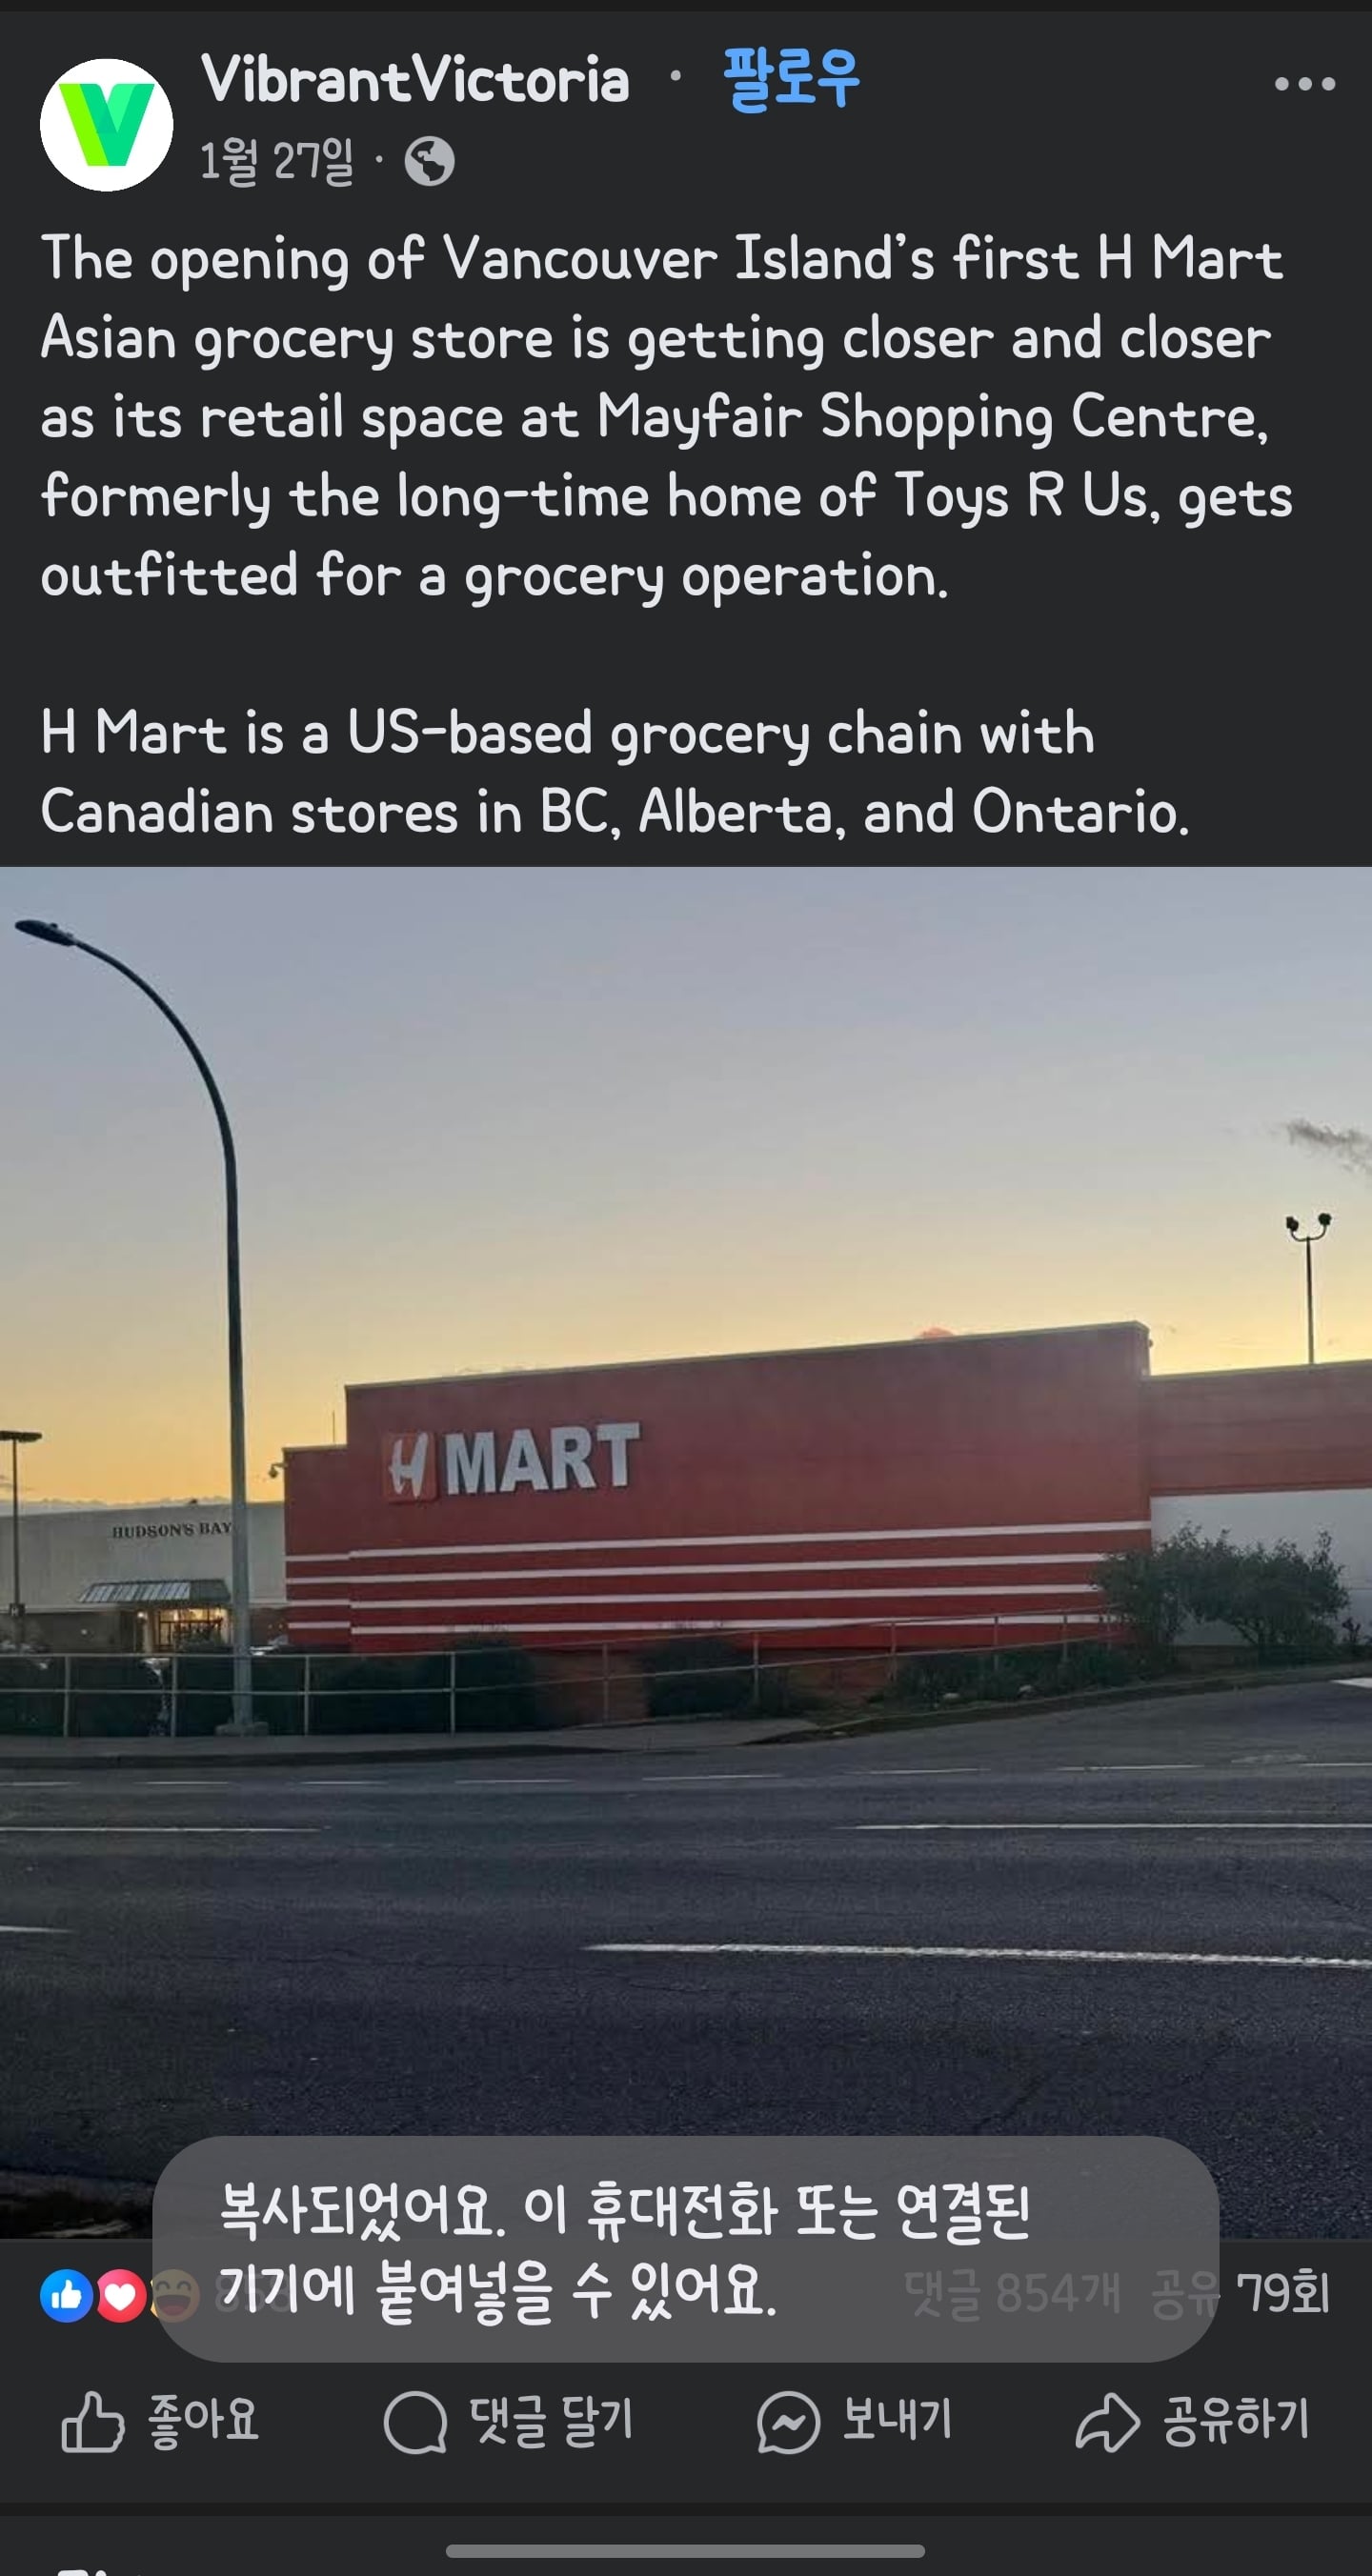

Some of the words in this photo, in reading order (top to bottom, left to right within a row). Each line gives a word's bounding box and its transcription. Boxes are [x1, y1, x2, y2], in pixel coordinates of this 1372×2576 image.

[389, 1432, 428, 1499] H
[445, 1421, 640, 1496] MART
[112, 1522, 194, 1540] HUDSON'S
[199, 1521, 232, 1536] BAY
